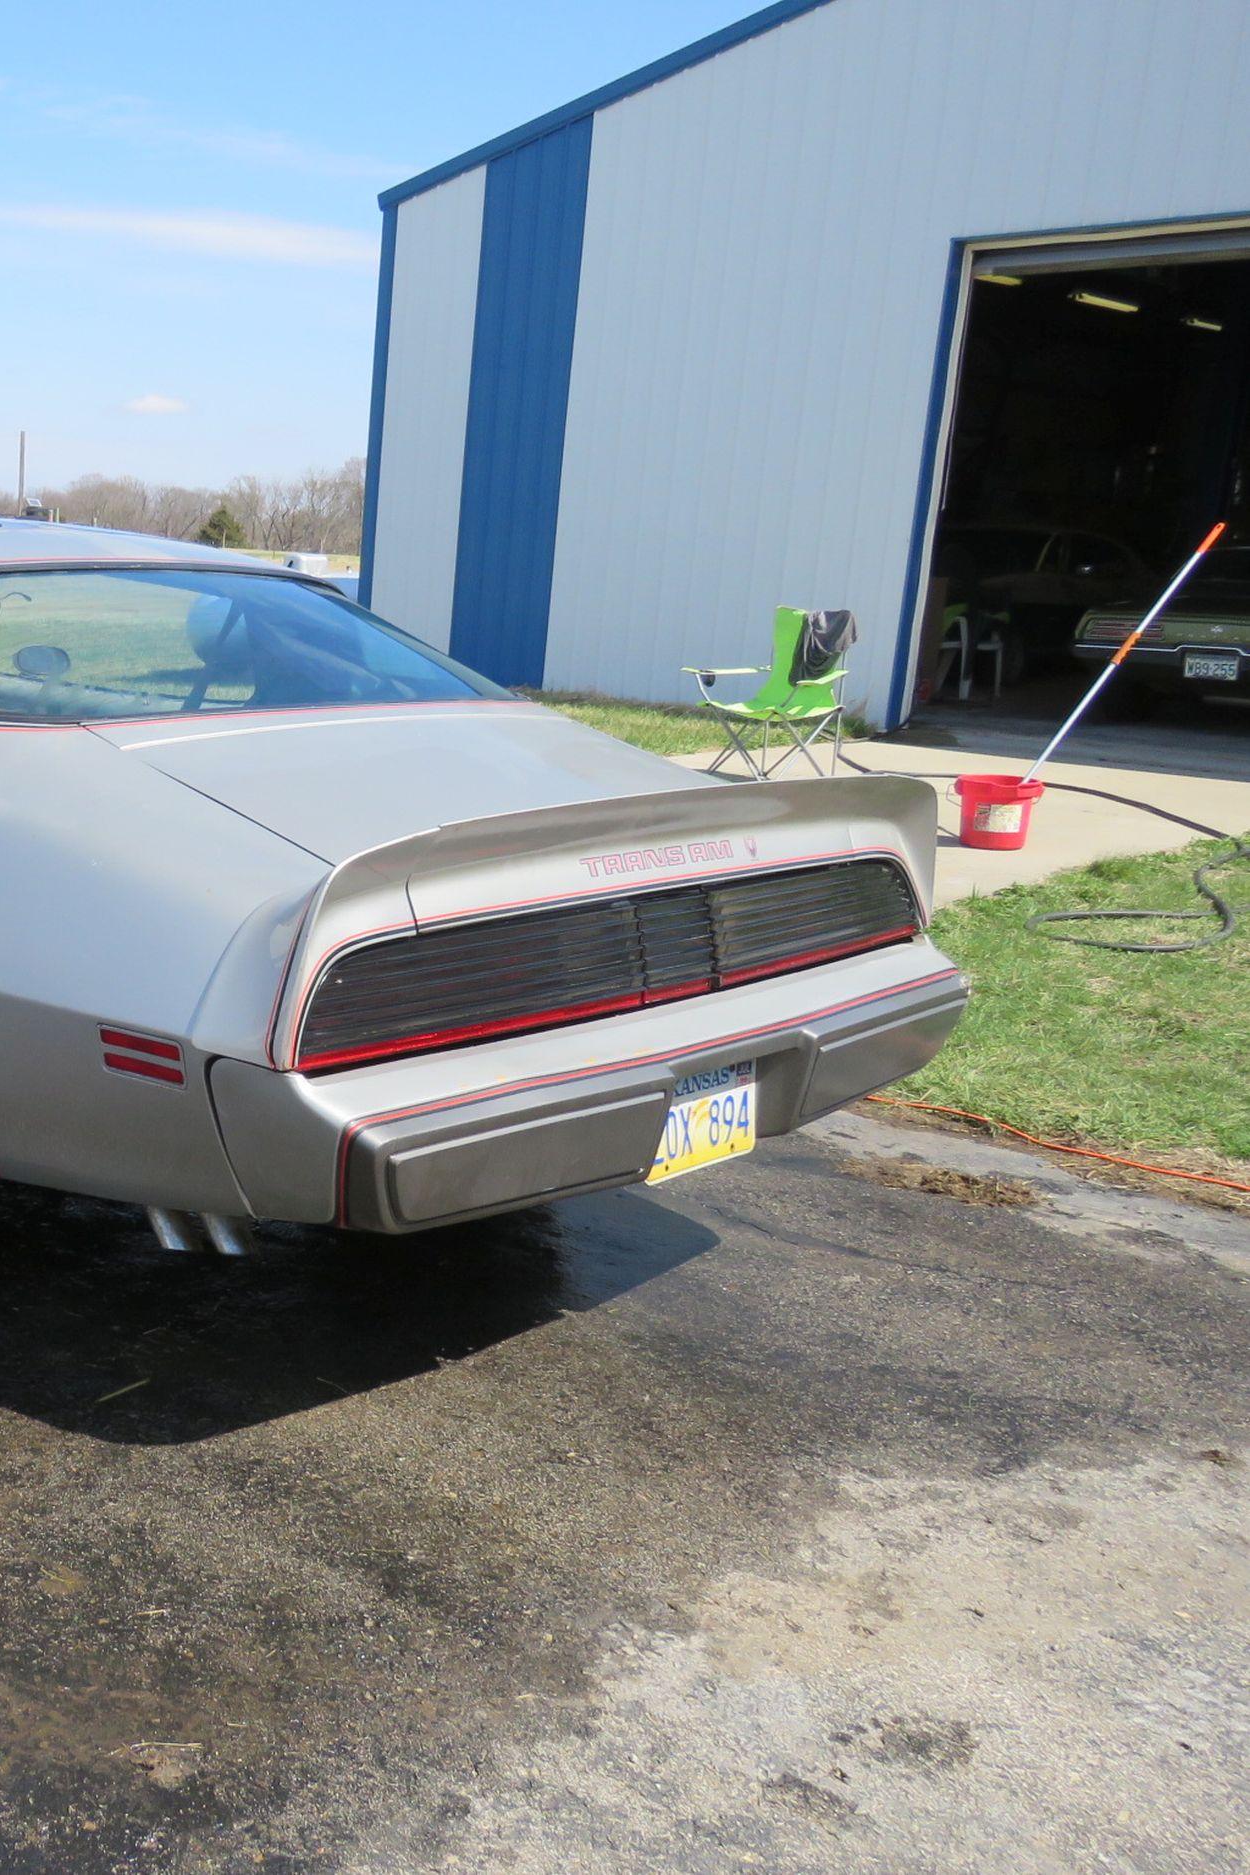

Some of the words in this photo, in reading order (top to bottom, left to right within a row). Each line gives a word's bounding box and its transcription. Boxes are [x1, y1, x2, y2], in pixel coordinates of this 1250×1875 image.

[580, 846, 687, 877] TRANS
[687, 840, 734, 863] AM
[654, 1108, 692, 1165] OX
[709, 1091, 749, 1145] 894
